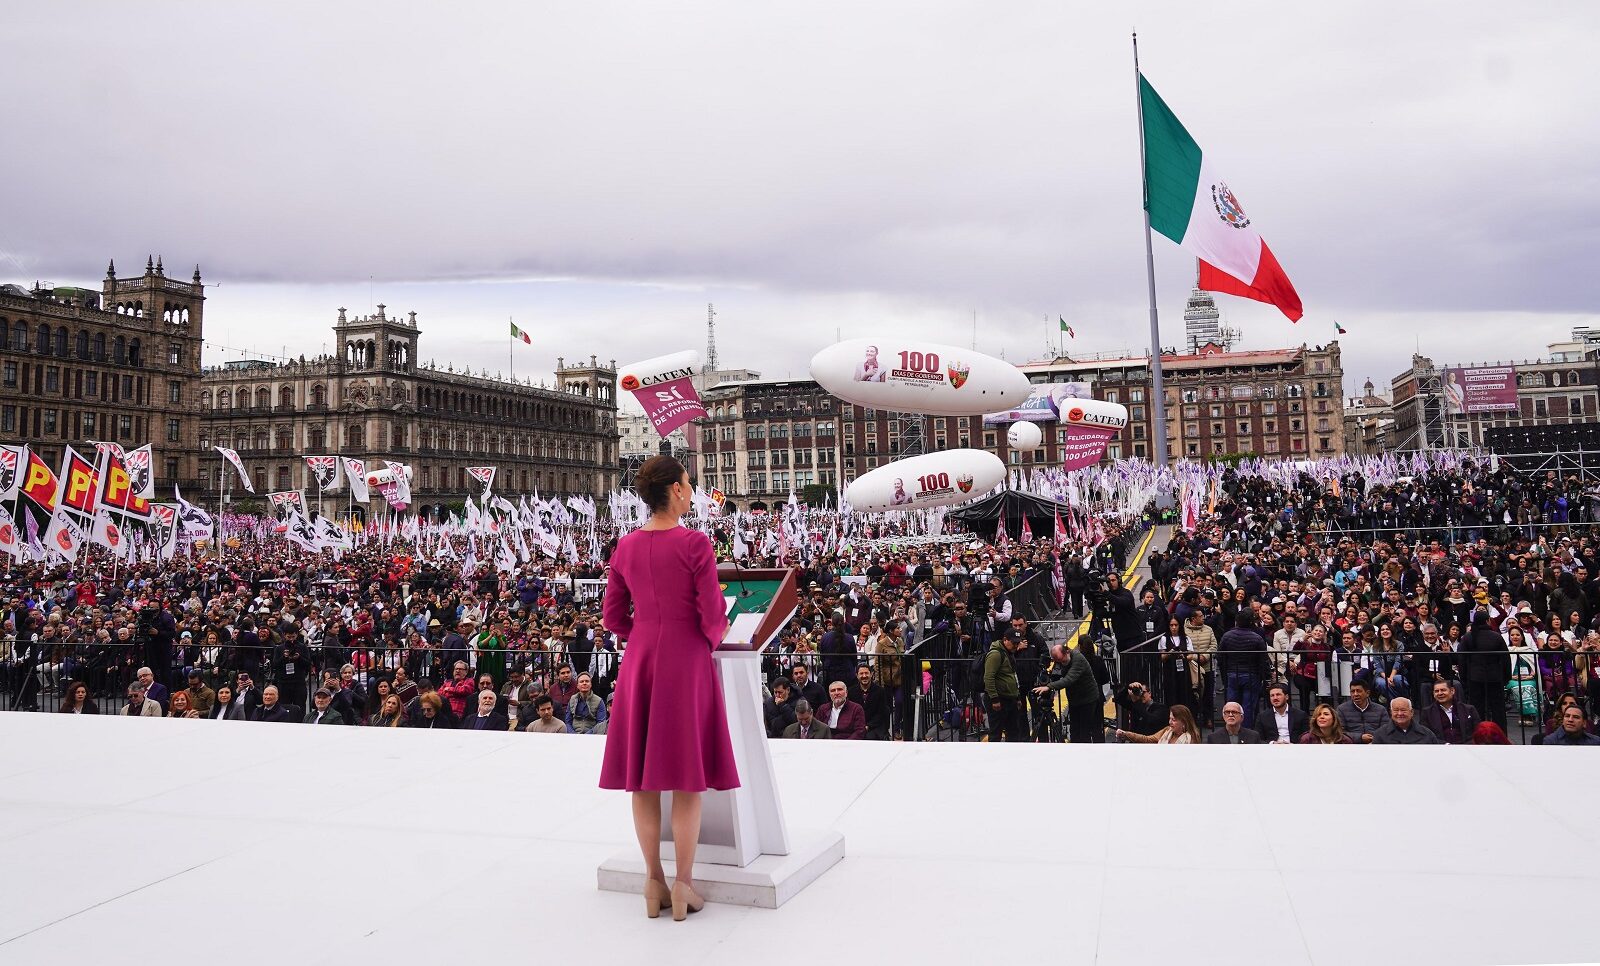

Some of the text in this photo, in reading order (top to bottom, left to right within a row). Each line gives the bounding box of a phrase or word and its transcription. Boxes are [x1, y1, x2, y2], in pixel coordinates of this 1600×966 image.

[898, 351, 940, 373] 100
[642, 366, 694, 386] CATEM
[914, 373, 943, 381] GOBIERNO
[656, 386, 684, 402] SÍ
[657, 405, 668, 414] LA
[654, 416, 668, 427] DE
[1083, 412, 1126, 427] CATEM
[1066, 441, 1106, 450] PRESIDENTA
[1081, 447, 1102, 459] DÍAS
[917, 472, 950, 492] 100
